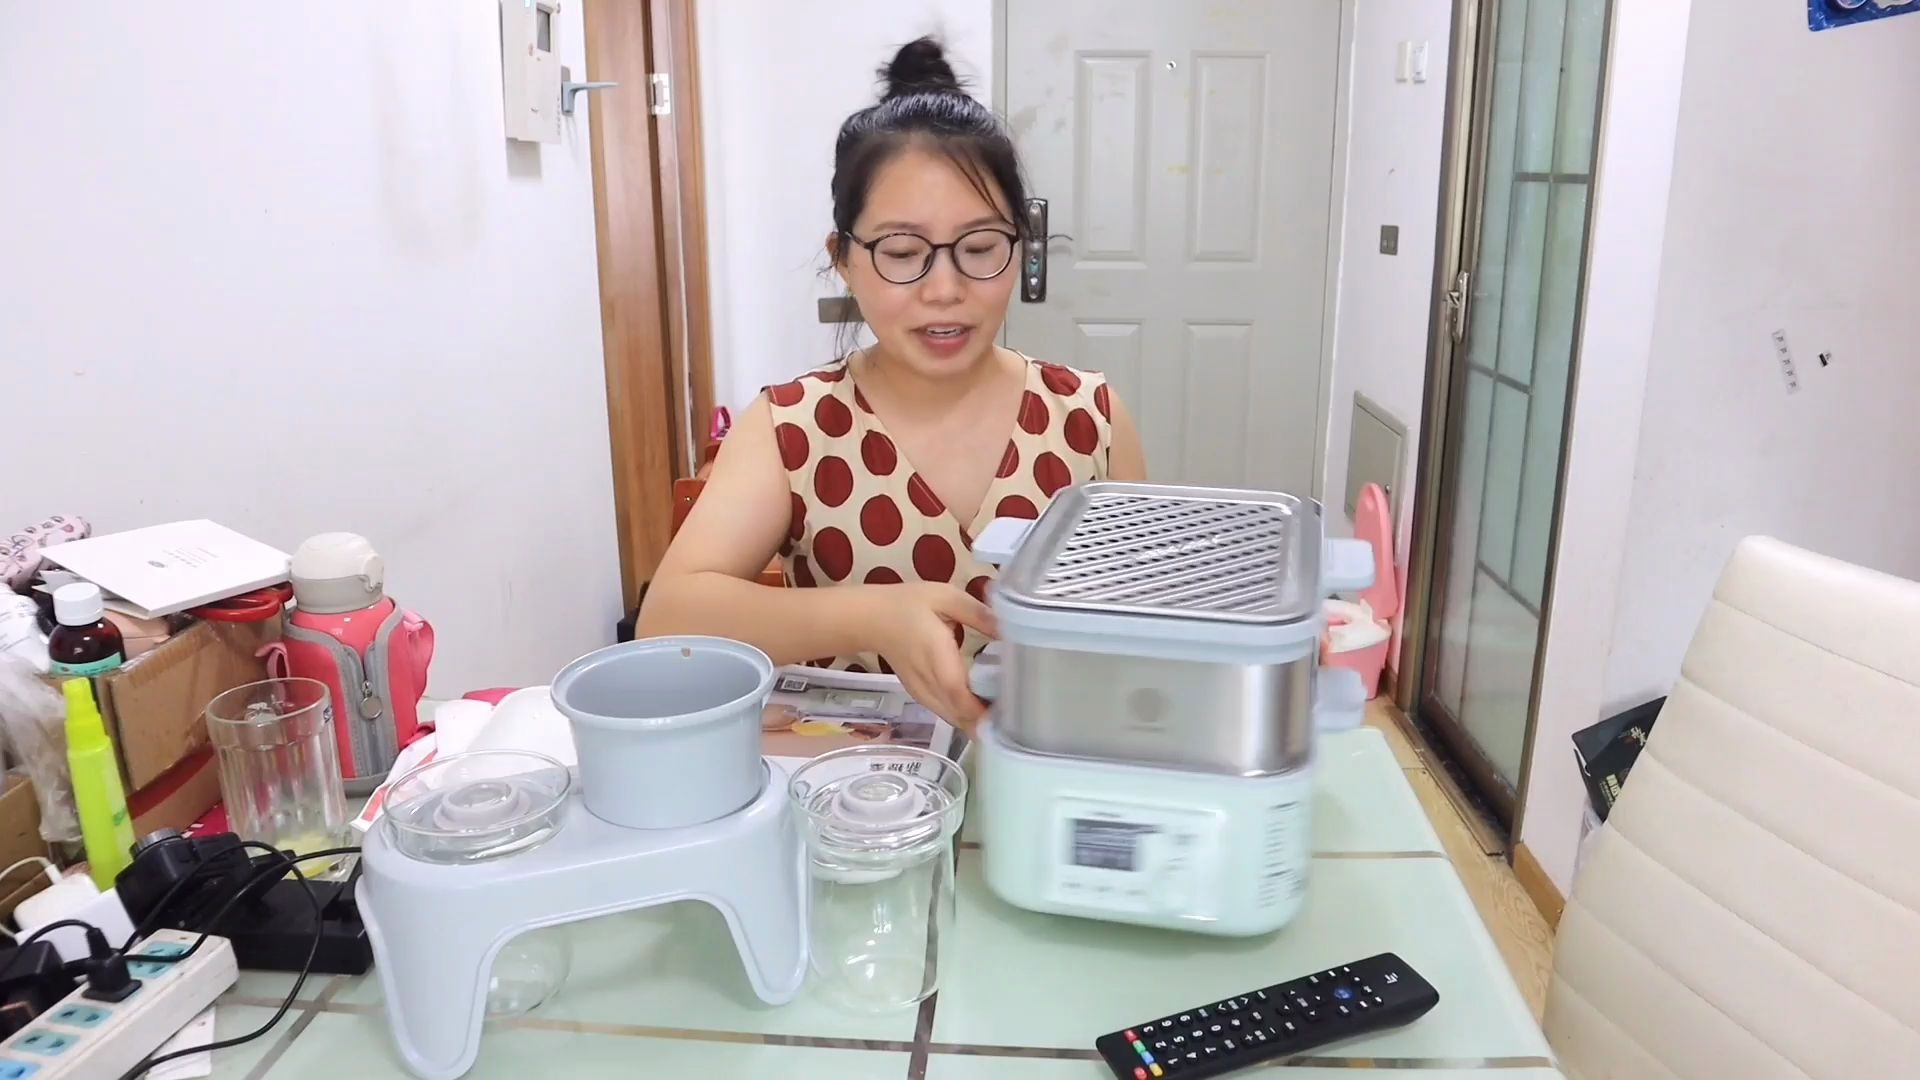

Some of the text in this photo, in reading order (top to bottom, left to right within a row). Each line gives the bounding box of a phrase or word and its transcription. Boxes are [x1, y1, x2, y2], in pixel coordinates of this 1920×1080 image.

[1180, 1014, 1191, 1022] 9
[1173, 1035, 1185, 1043] 5
[1155, 1040, 1167, 1049] 2
[1186, 1051, 1197, 1059] 4
